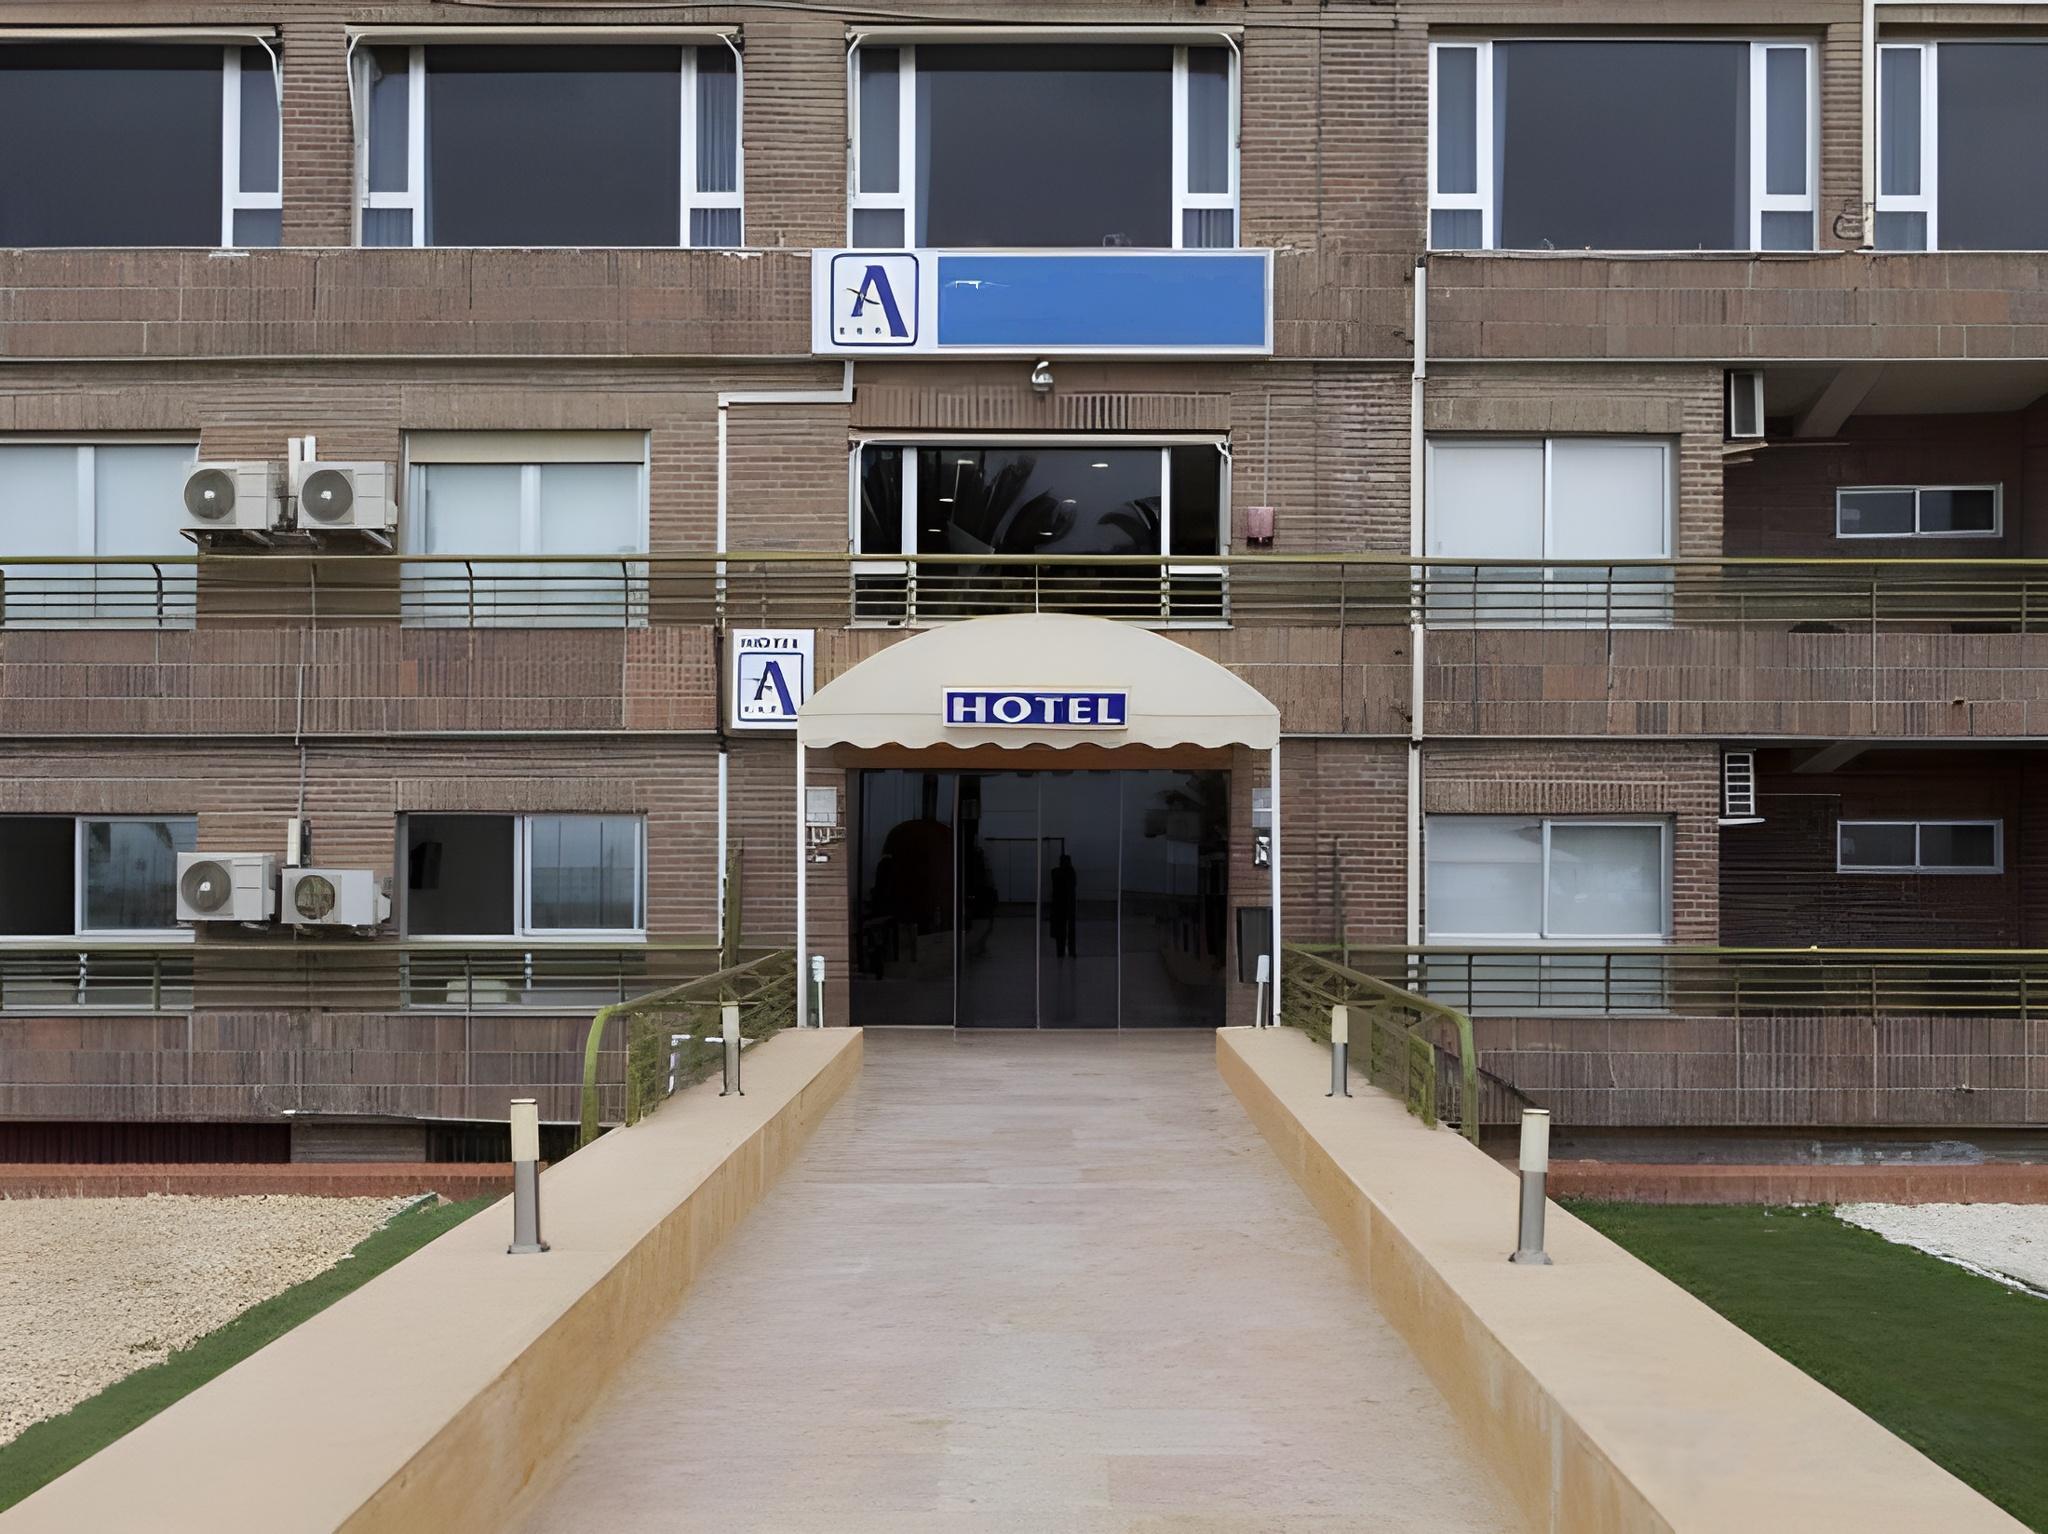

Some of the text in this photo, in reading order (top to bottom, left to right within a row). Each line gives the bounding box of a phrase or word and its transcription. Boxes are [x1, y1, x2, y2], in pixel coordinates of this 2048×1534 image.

[846, 265, 909, 338] A
[752, 660, 798, 715] A
[953, 696, 1121, 724] HOTEL
